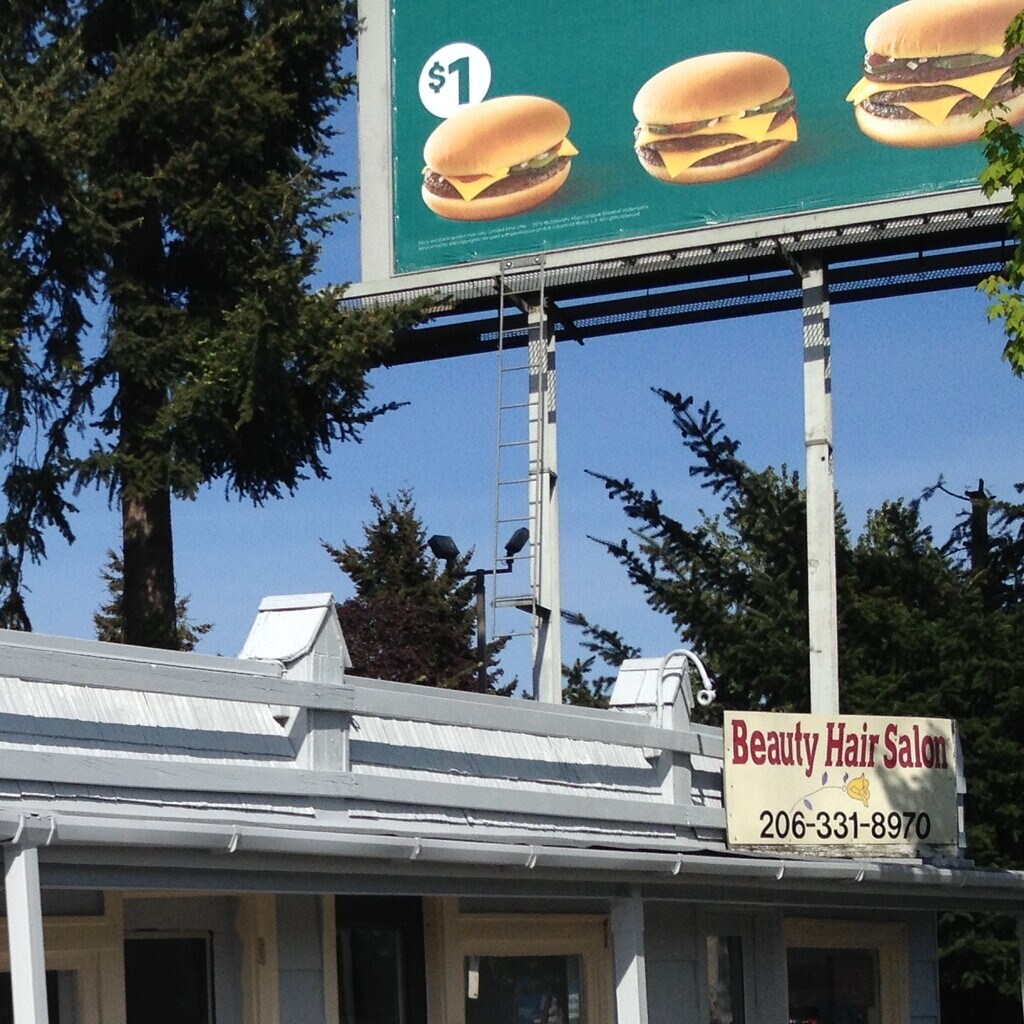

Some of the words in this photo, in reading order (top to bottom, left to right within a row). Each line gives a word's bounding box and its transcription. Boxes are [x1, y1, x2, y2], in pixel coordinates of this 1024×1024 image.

[428, 56, 470, 105] $1
[731, 719, 819, 777] Beauty
[824, 721, 880, 768] Hair
[883, 723, 949, 769] Salon
[759, 810, 931, 840] 206-331-8970
